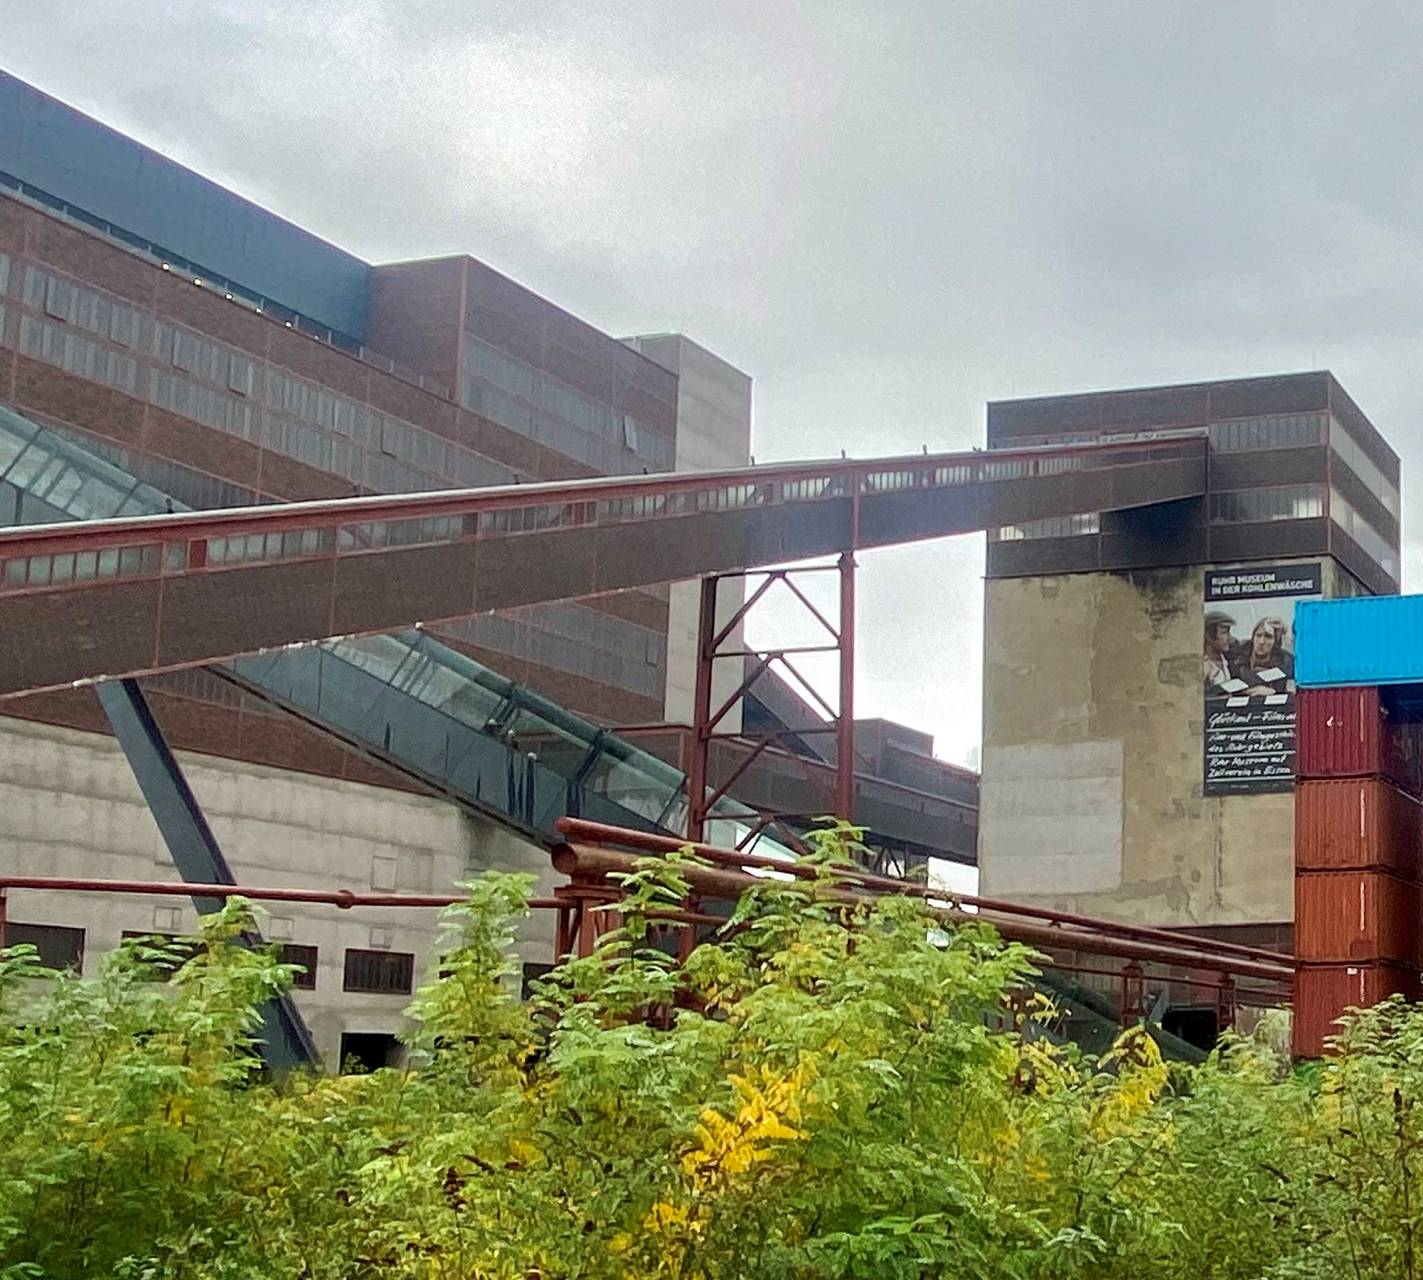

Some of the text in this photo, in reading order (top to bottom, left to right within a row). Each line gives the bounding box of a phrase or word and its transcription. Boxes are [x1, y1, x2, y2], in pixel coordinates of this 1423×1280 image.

[1237, 573, 1276, 583] MUSEUM
[1211, 586, 1221, 595] IN
[1222, 584, 1241, 594] DER
